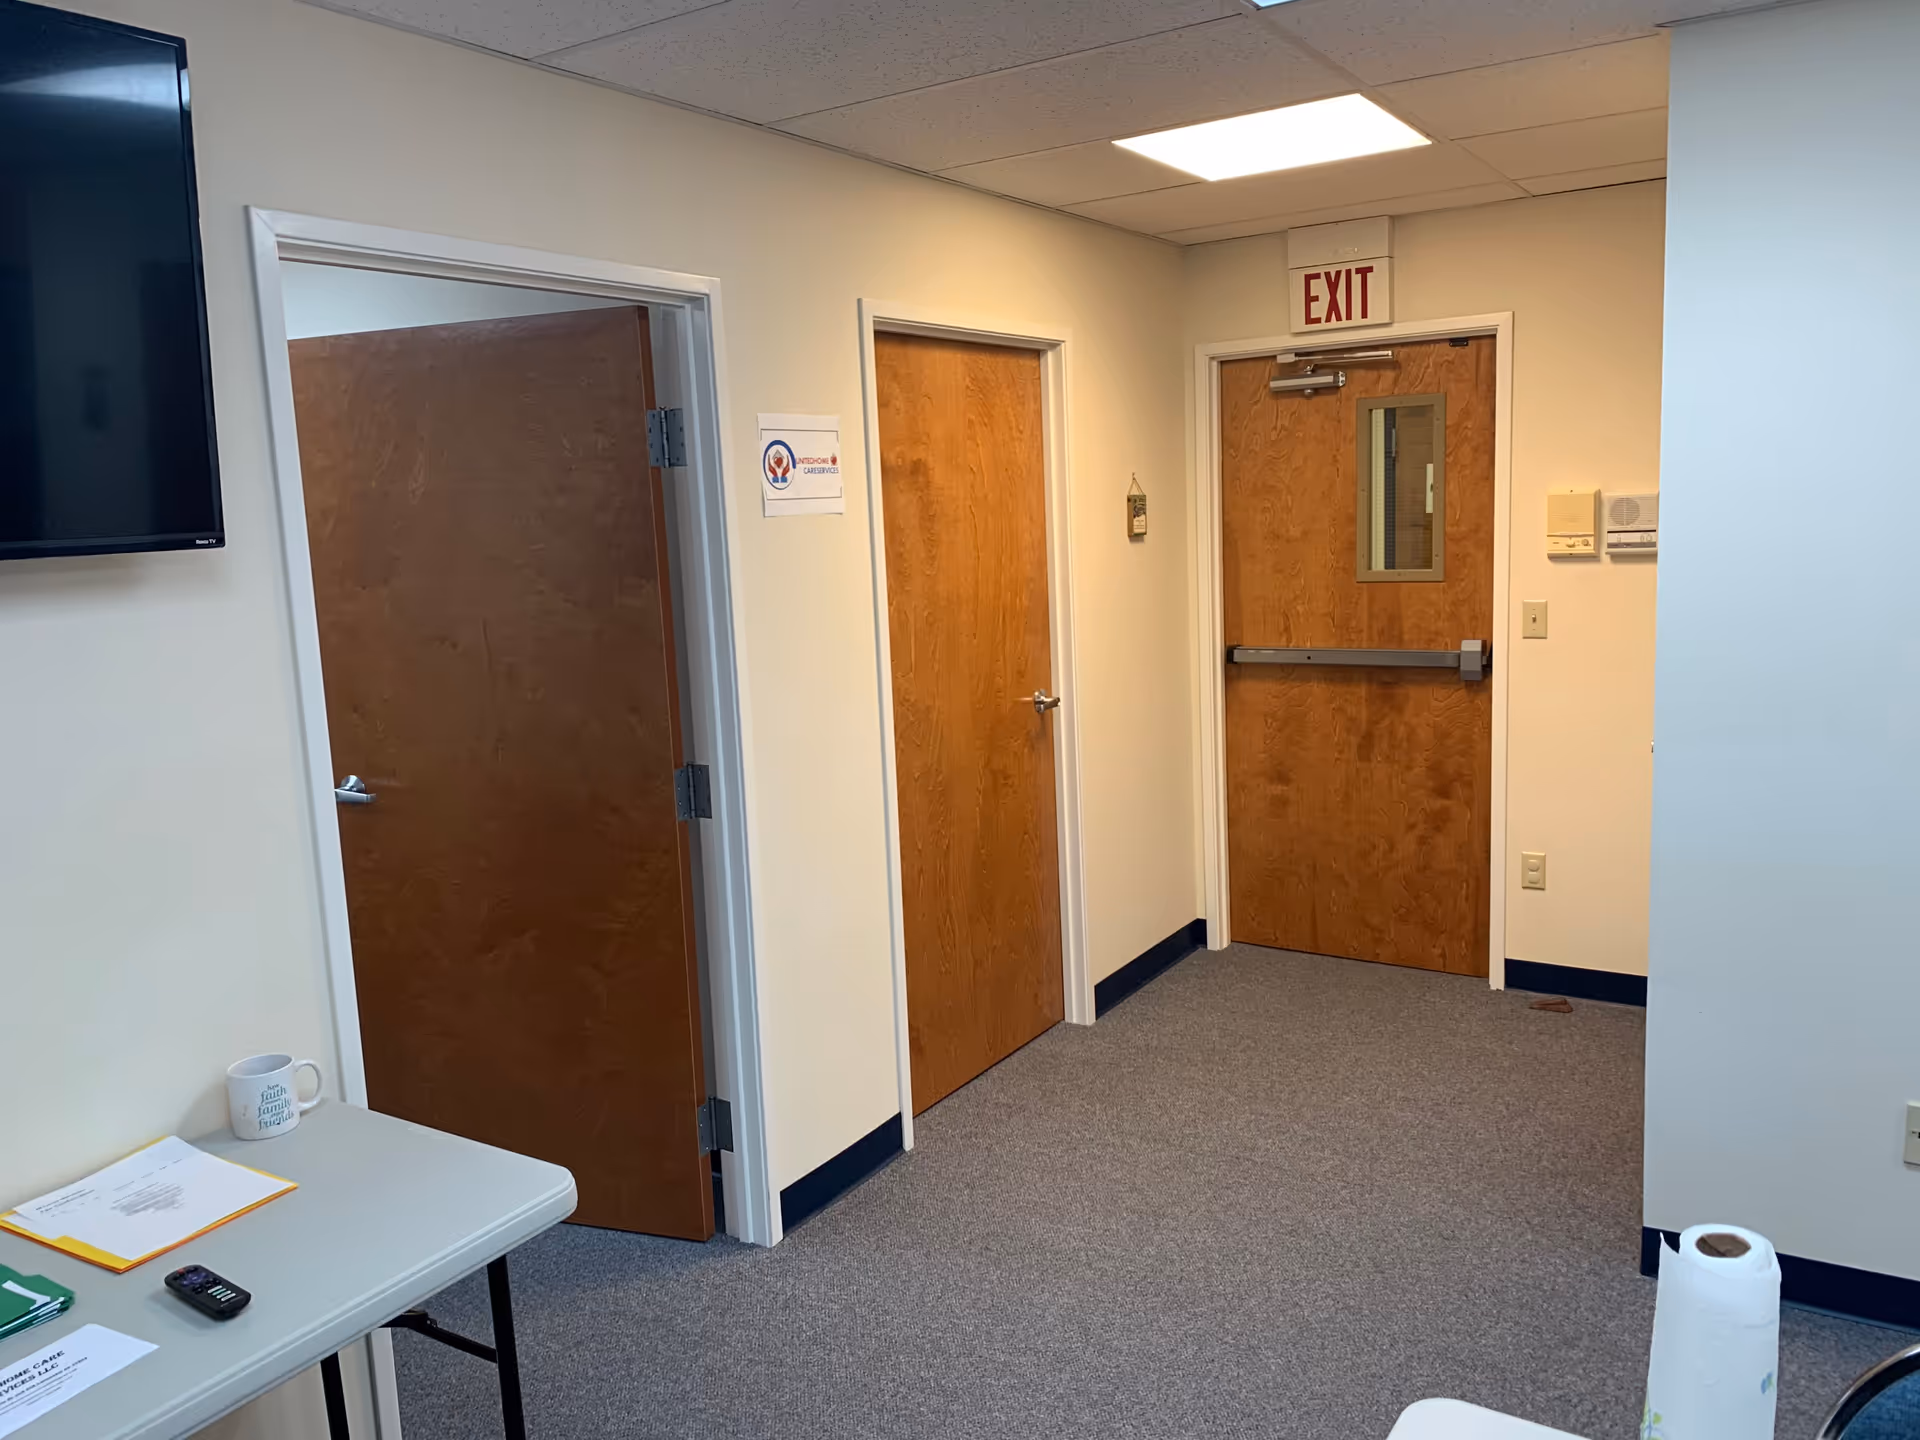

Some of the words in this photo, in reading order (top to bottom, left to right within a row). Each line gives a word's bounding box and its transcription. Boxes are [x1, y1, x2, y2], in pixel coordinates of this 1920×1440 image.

[1304, 265, 1374, 325] EXIT
[261, 1086, 287, 1105] faith
[258, 1097, 292, 1118] family
[32, 1350, 65, 1370] CARE
[37, 1362, 59, 1376] LLC
